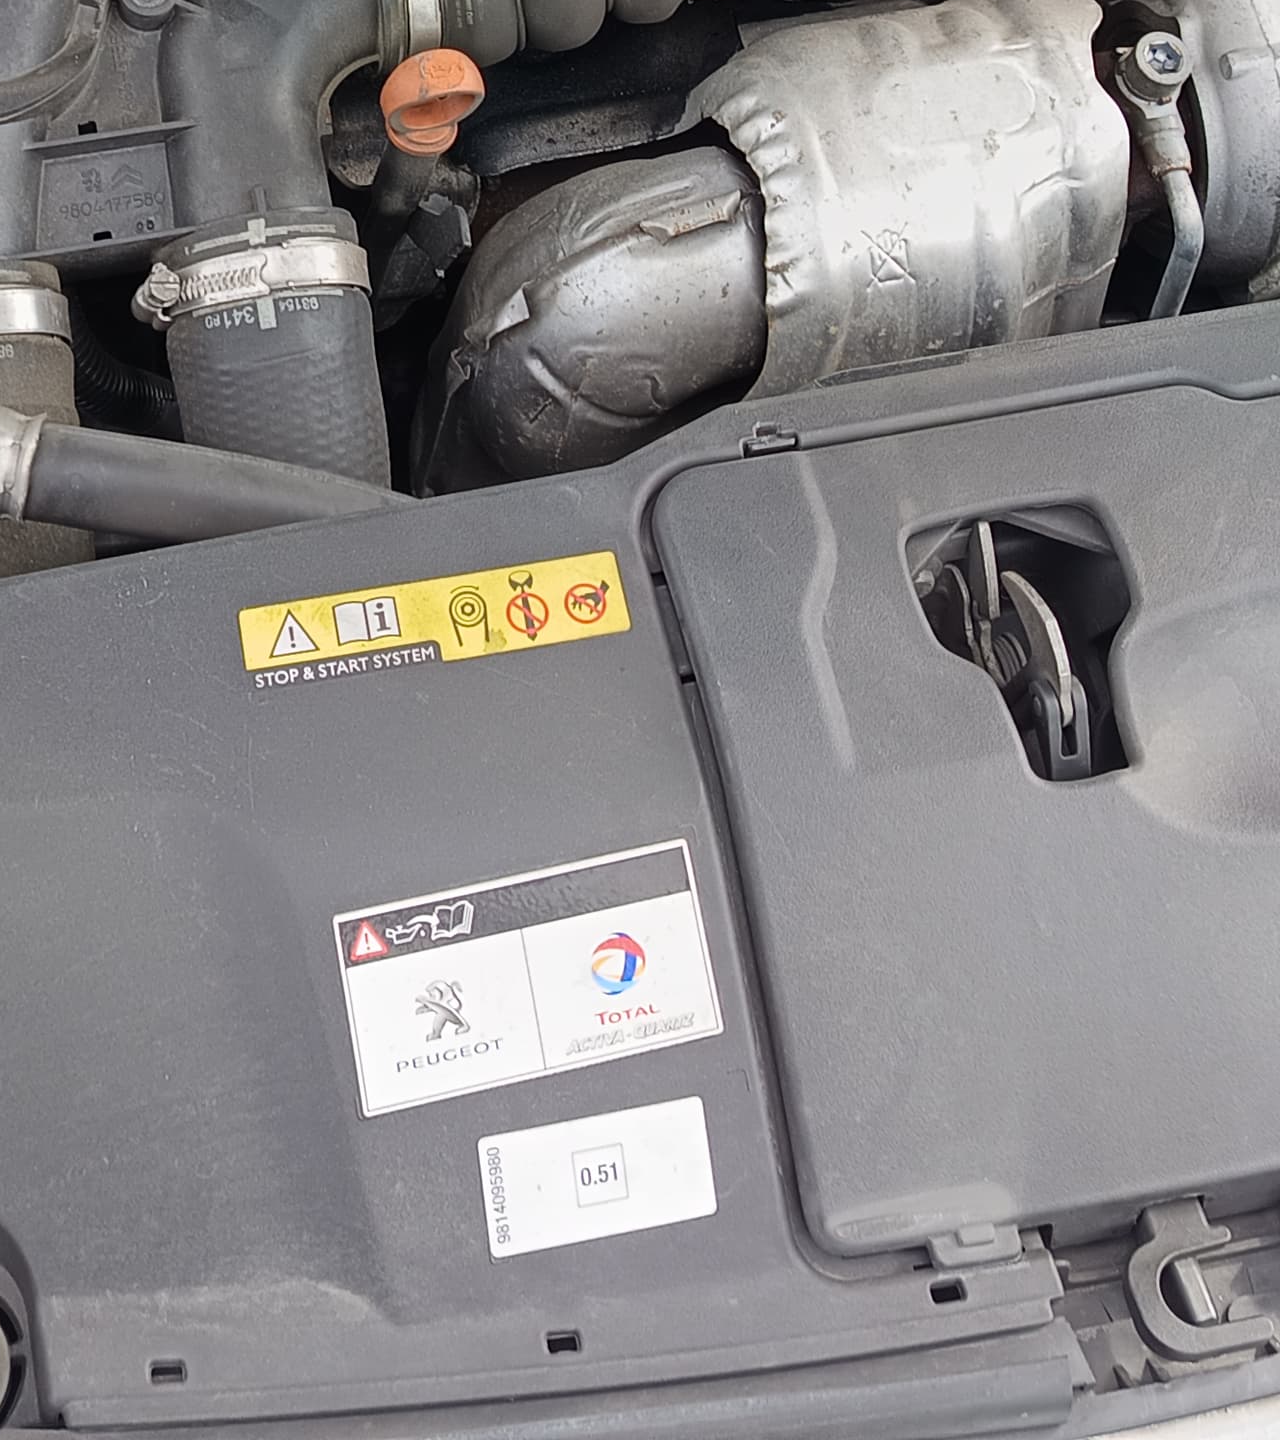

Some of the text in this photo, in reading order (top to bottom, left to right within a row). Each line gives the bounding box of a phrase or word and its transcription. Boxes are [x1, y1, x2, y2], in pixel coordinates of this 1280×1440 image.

[255, 646, 436, 688] STOP & START SYSTEM
[396, 1037, 505, 1073] PEUGEOT
[580, 1162, 619, 1186] 0.51
[486, 1146, 511, 1244] 9814095980
